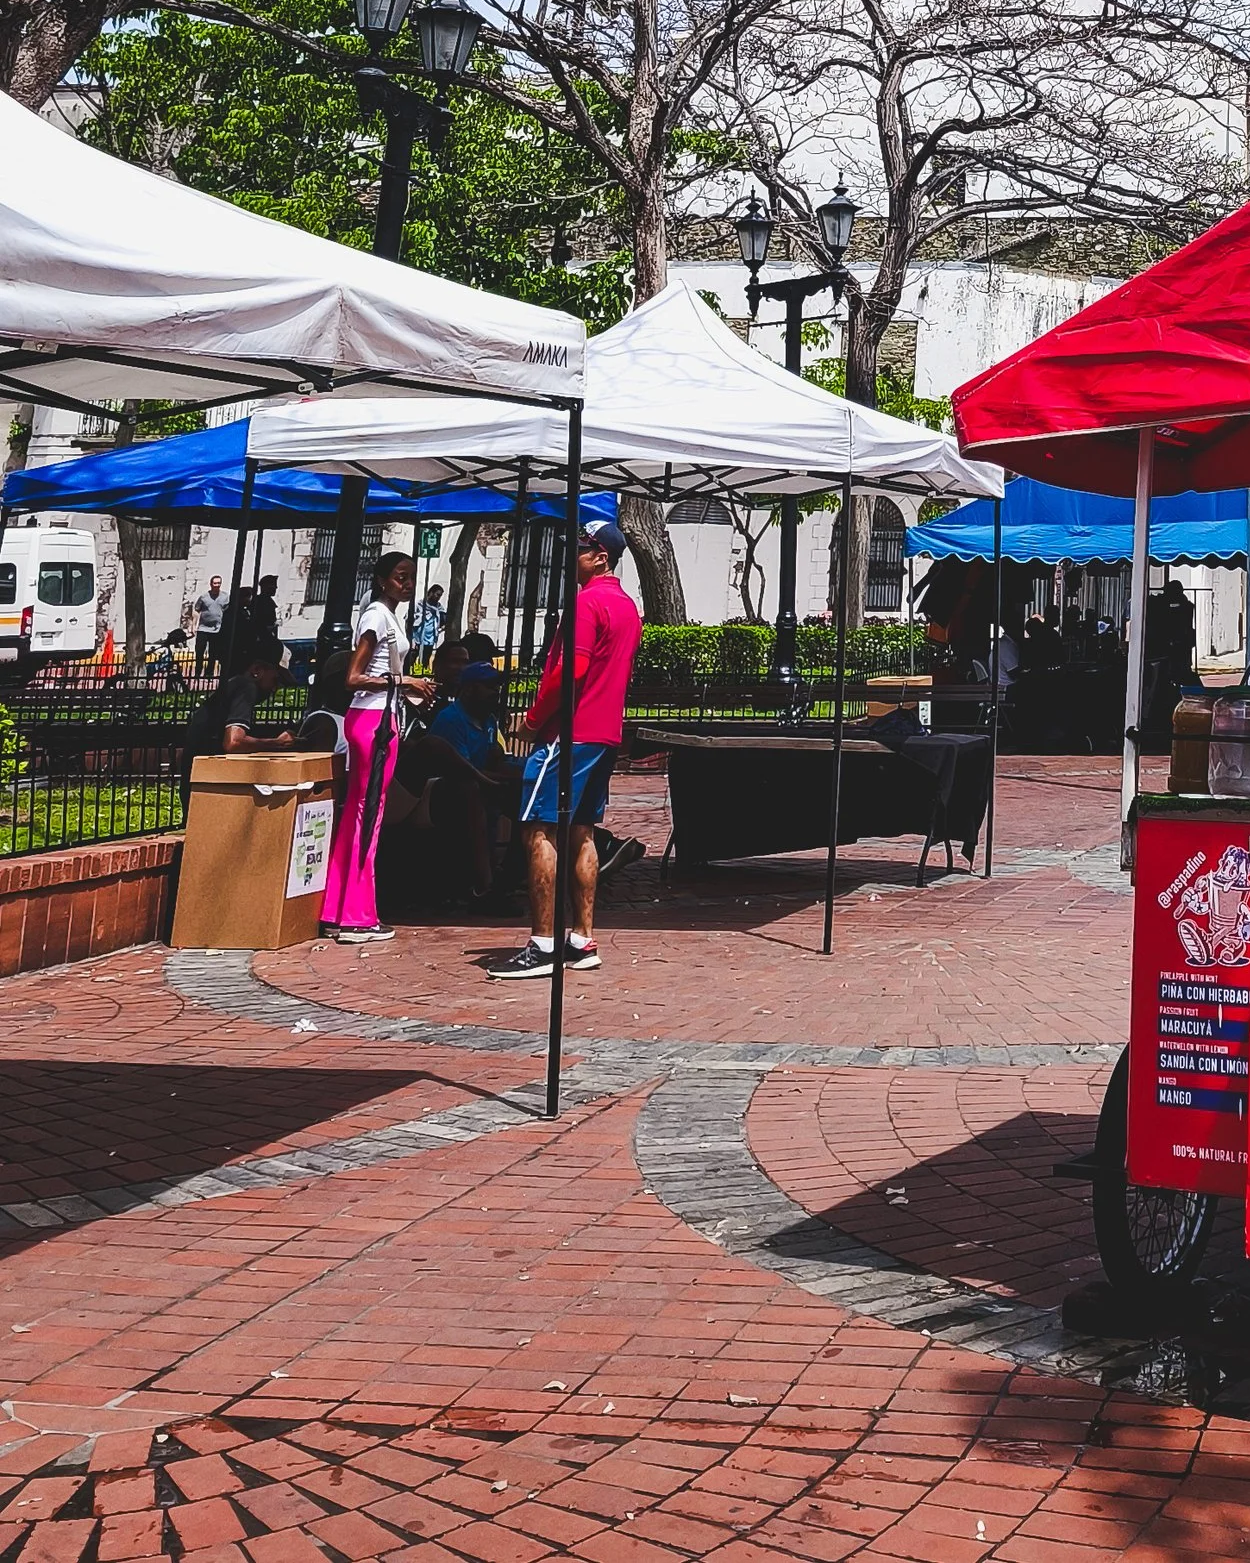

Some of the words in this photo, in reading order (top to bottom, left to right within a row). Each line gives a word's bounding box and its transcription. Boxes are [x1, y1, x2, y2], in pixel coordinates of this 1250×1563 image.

[522, 340, 567, 368] AMAKA
[1157, 851, 1207, 909] @raspadino
[1161, 982, 1183, 999] PIÑA
[1186, 986, 1205, 1001] CON
[1161, 1018, 1212, 1036] MARACUYÁ
[1160, 1053, 1195, 1071] SANDÍA
[1198, 1057, 1217, 1072] CON
[1220, 1057, 1249, 1075] LIMÓN
[1159, 1088, 1192, 1106] MANGO
[1172, 1144, 1197, 1159] 100%
[1199, 1147, 1235, 1163] NATURAL
